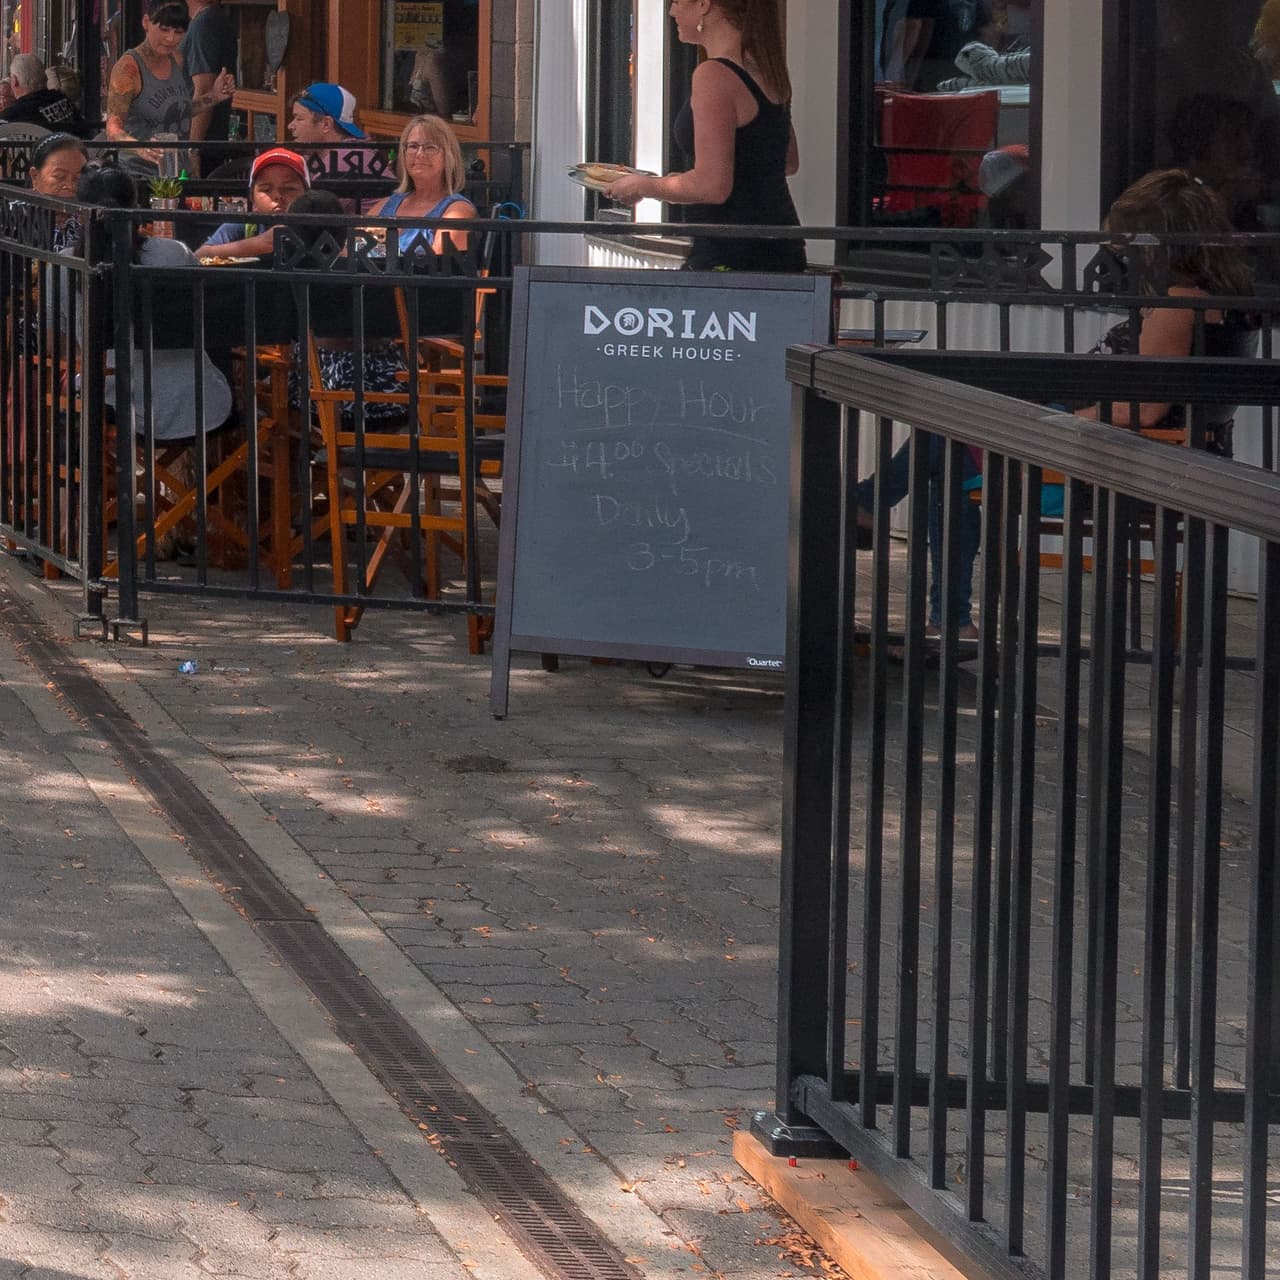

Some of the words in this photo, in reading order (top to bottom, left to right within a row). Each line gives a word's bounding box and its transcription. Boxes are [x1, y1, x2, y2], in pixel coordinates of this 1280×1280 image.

[274, 225, 482, 278] DORIAN
[584, 305, 757, 342] DORIAN
[604, 343, 664, 359] GREEK
[672, 347, 734, 362] HOUSE
[678, 377, 774, 424] Hour
